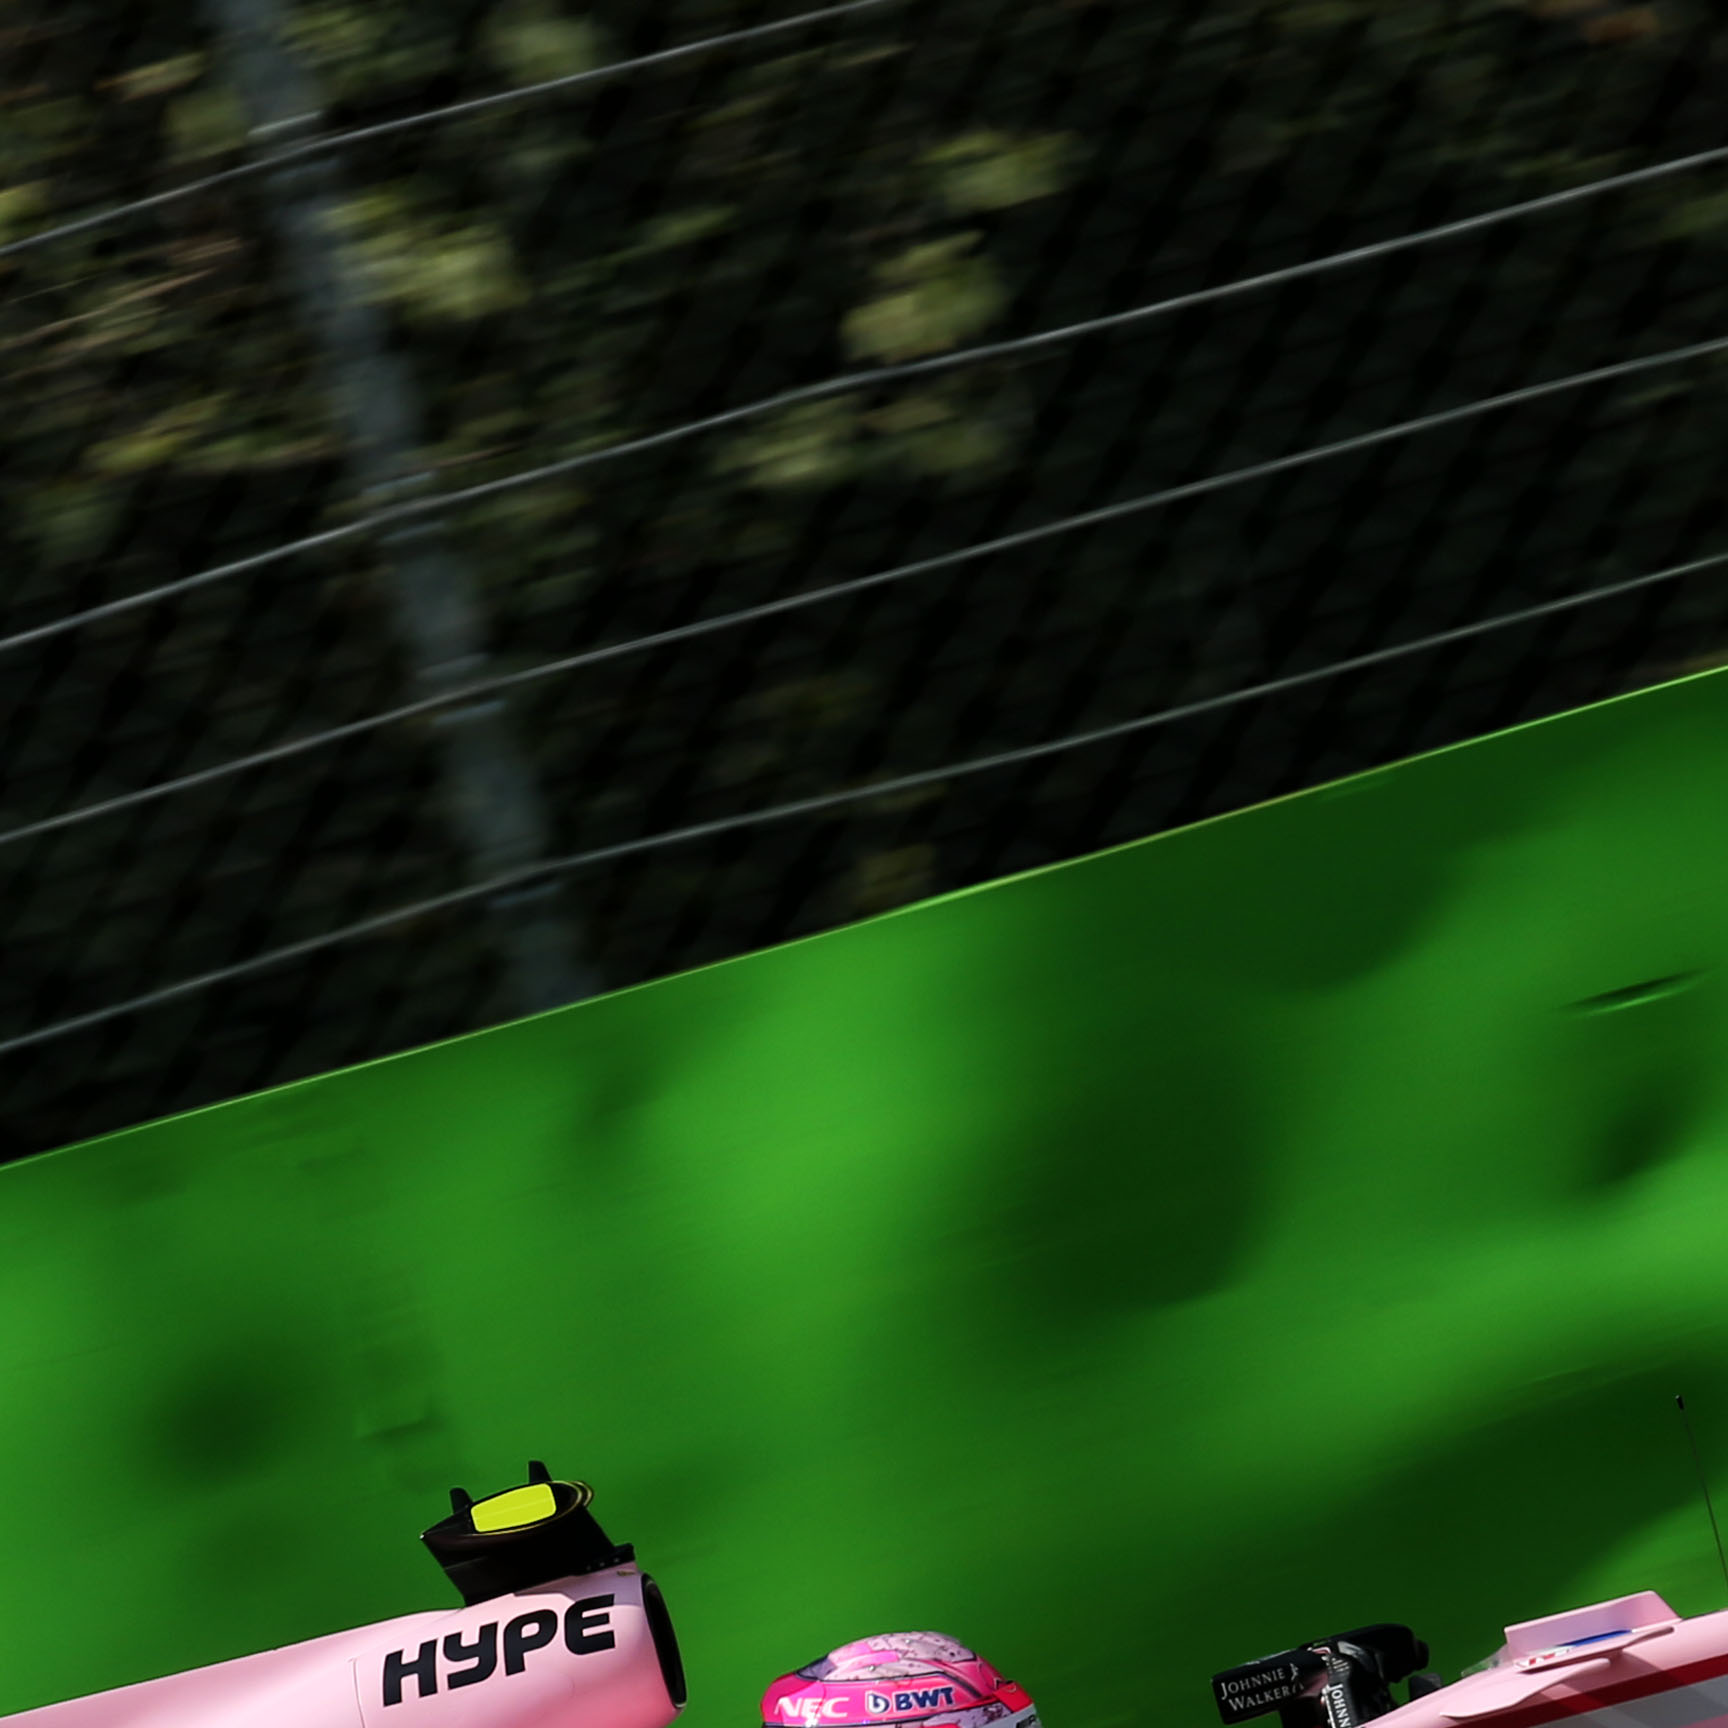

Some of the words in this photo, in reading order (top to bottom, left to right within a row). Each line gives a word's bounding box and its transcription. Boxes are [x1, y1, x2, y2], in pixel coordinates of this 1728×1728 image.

[383, 1594, 616, 1707] HYPE
[1221, 1667, 1285, 1699] JOHNNIE
[774, 1696, 849, 1718] NEC
[892, 1687, 954, 1712] BWT
[1228, 1685, 1293, 1712] WALKER
